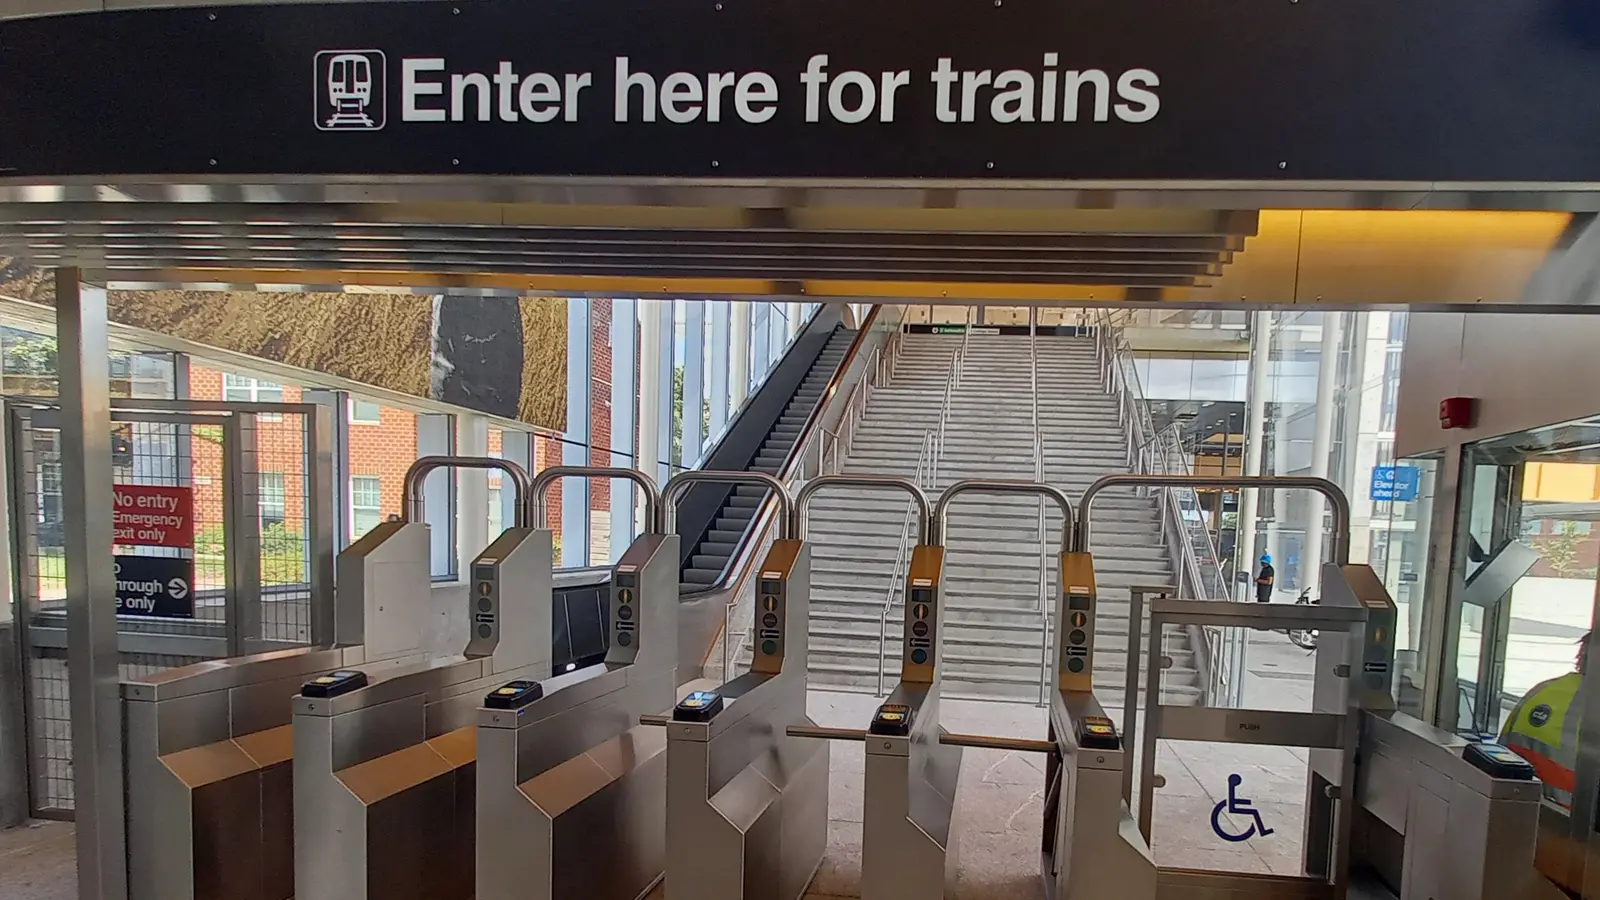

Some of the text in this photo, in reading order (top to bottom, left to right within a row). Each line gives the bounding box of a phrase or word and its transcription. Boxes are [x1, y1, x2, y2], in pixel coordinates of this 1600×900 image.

[402, 52, 1160, 124] Enter here for trains
[112, 491, 178, 513] No entry
[112, 510, 183, 529] Emergency
[112, 527, 166, 543] exit only
[115, 579, 163, 596] hrough
[125, 596, 156, 613] only
